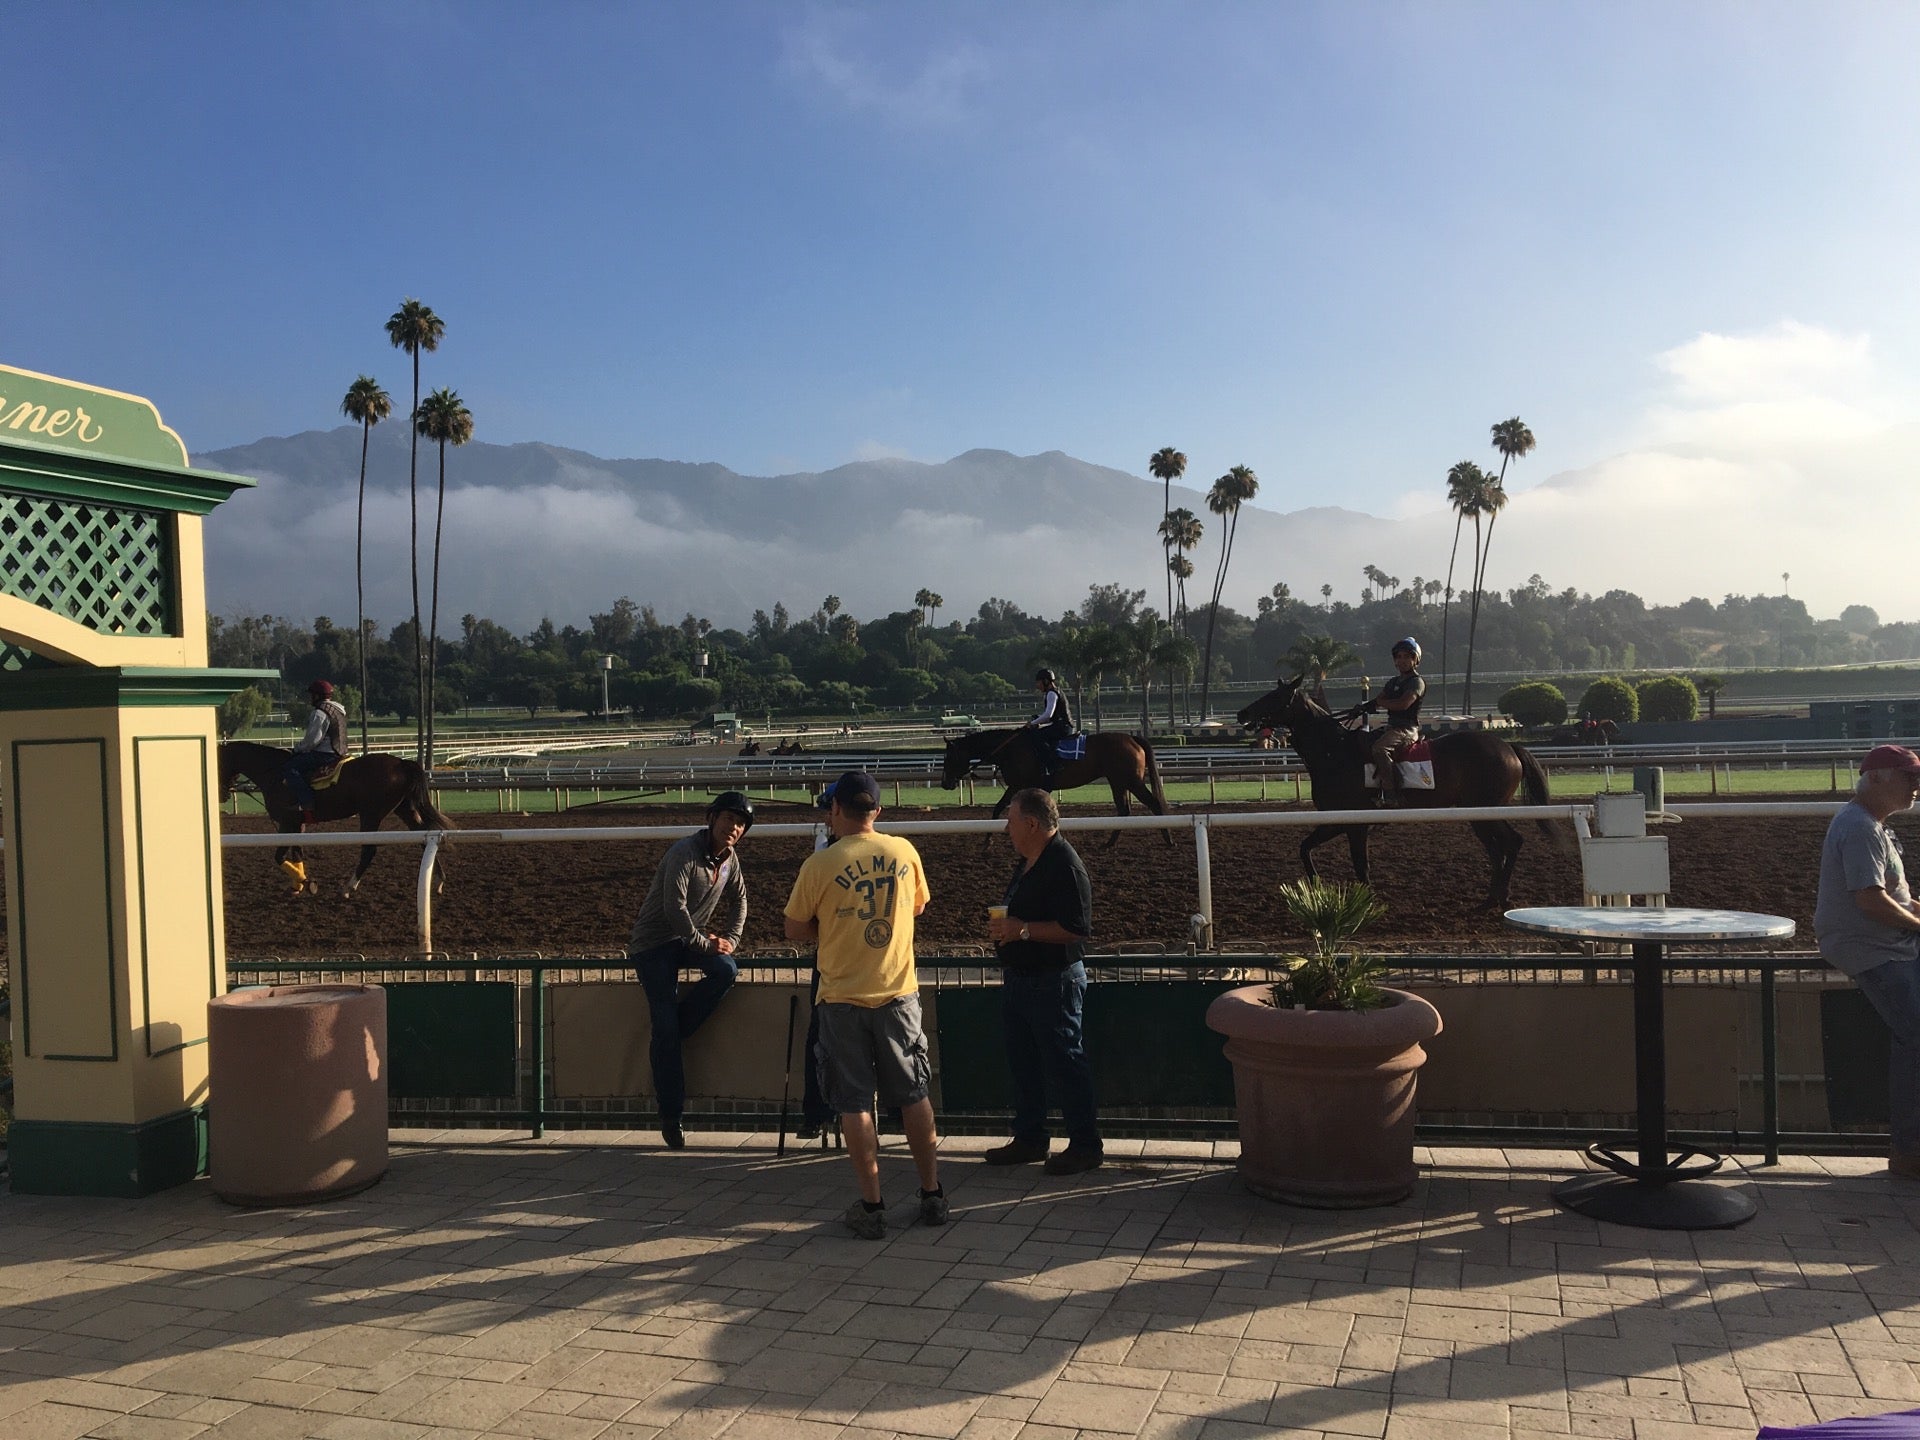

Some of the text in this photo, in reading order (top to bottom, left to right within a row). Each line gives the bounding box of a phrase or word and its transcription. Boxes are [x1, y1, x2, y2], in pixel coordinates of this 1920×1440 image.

[1887, 704, 1895, 713] 6
[1841, 722, 1848, 731] 2
[1888, 721, 1896, 730] 7
[835, 855, 909, 890] DEL MAR
[855, 876, 895, 920] 37
